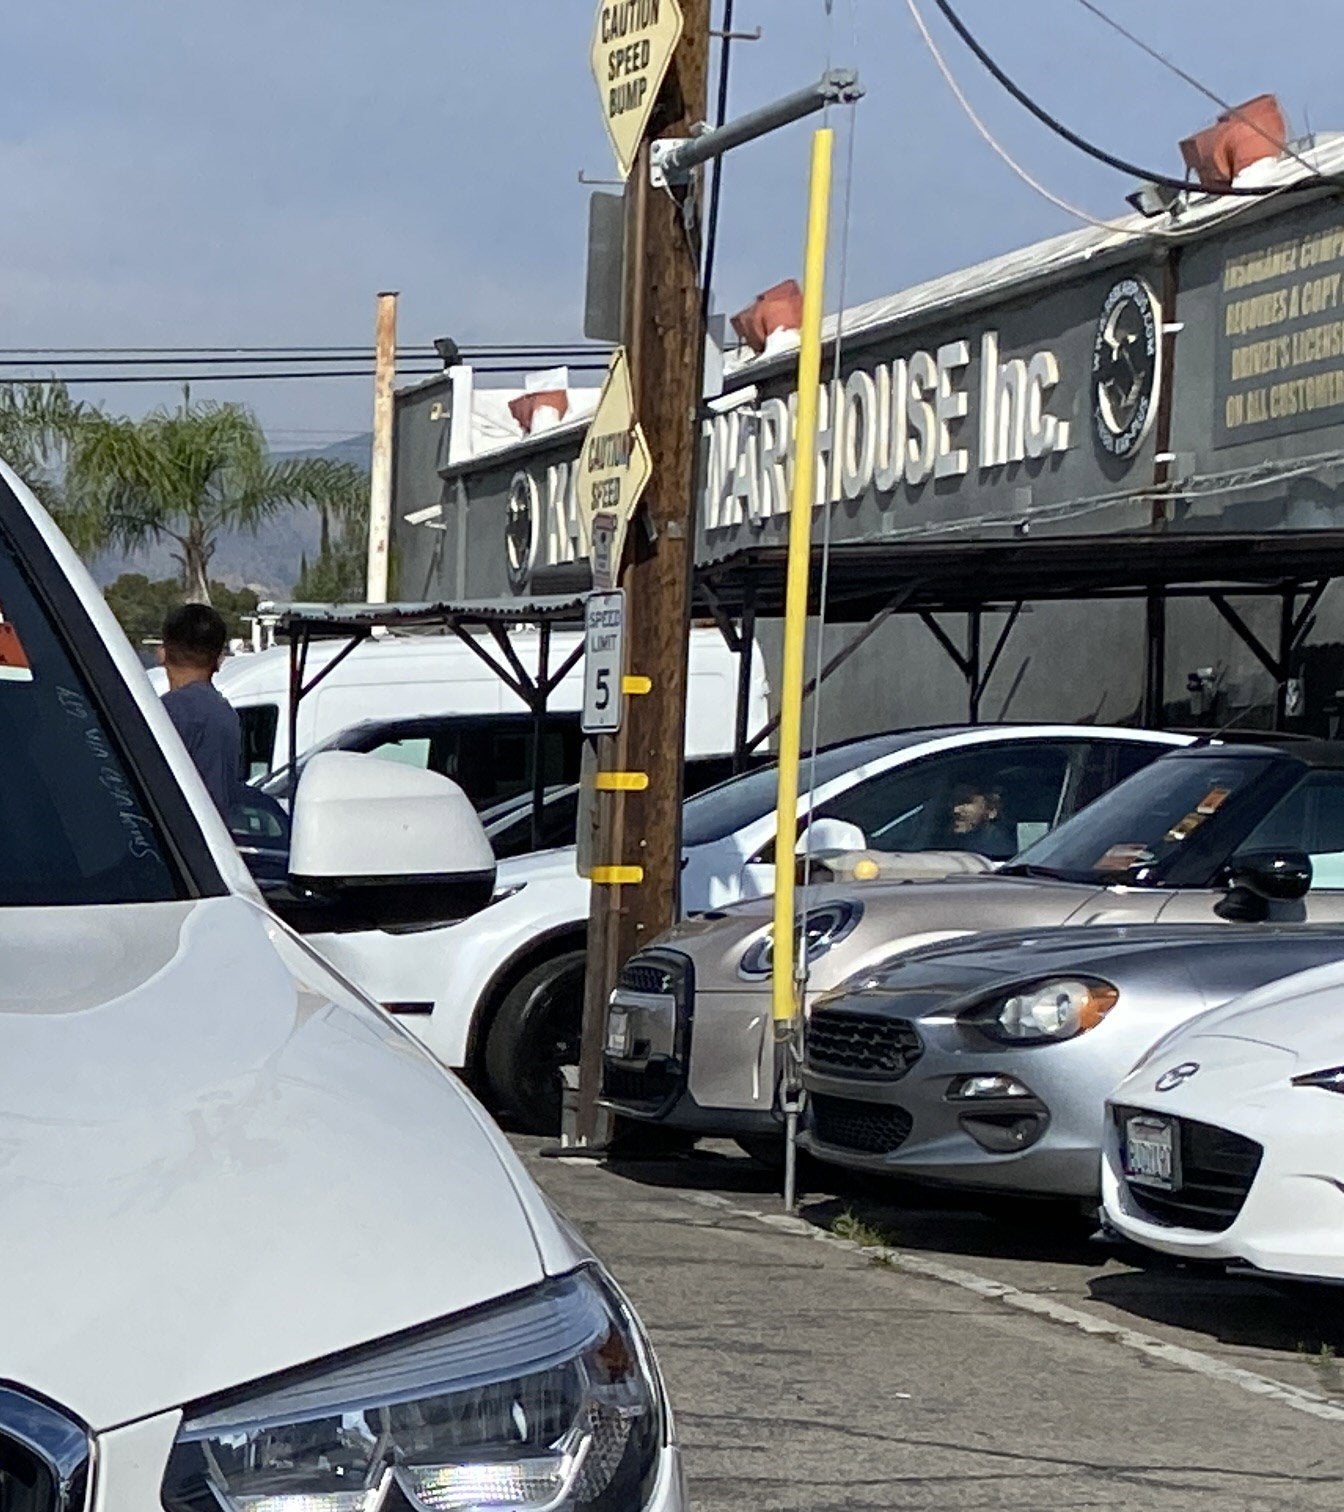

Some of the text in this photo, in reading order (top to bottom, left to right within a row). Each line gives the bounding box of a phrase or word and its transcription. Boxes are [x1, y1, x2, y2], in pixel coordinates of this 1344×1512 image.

[601, 0, 659, 43] CAUTION
[608, 39, 650, 81] SPEED
[609, 76, 647, 118] BUMP
[1301, 272, 1341, 316] COPY
[1291, 320, 1344, 366] LICENS
[978, 331, 1070, 467] Inc.
[588, 430, 632, 473] CAUTION
[591, 476, 620, 510] SPEED
[589, 609, 621, 627] SPEED
[590, 634, 618, 652] LIMIT
[594, 668, 611, 711] 5
